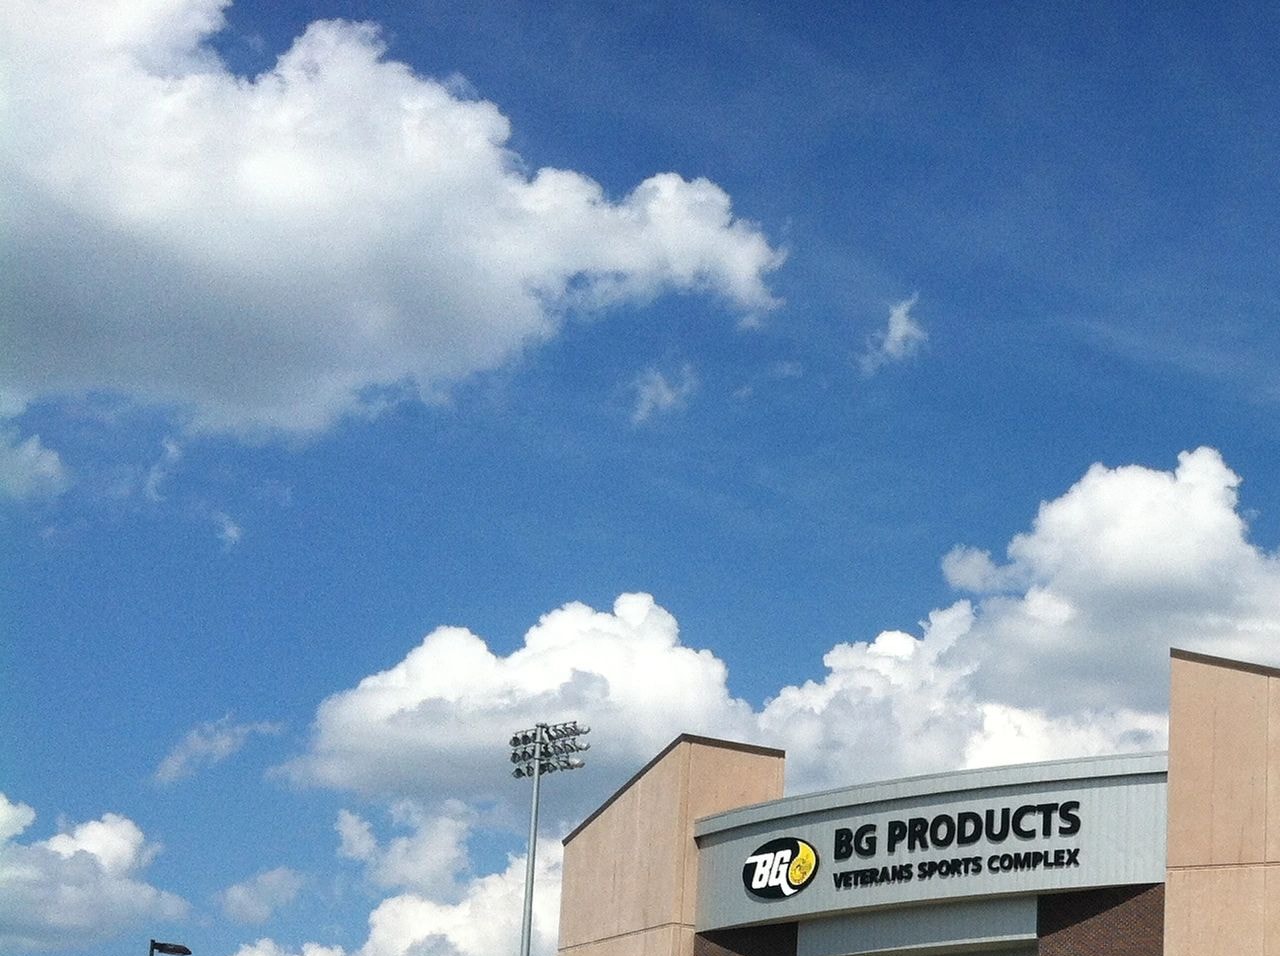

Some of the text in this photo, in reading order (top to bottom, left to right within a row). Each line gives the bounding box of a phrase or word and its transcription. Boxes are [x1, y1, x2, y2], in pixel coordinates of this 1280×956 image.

[833, 801, 1082, 861] BG PRODUCTS
[833, 848, 1081, 890] VETERANS SPORTS COMPLEX
